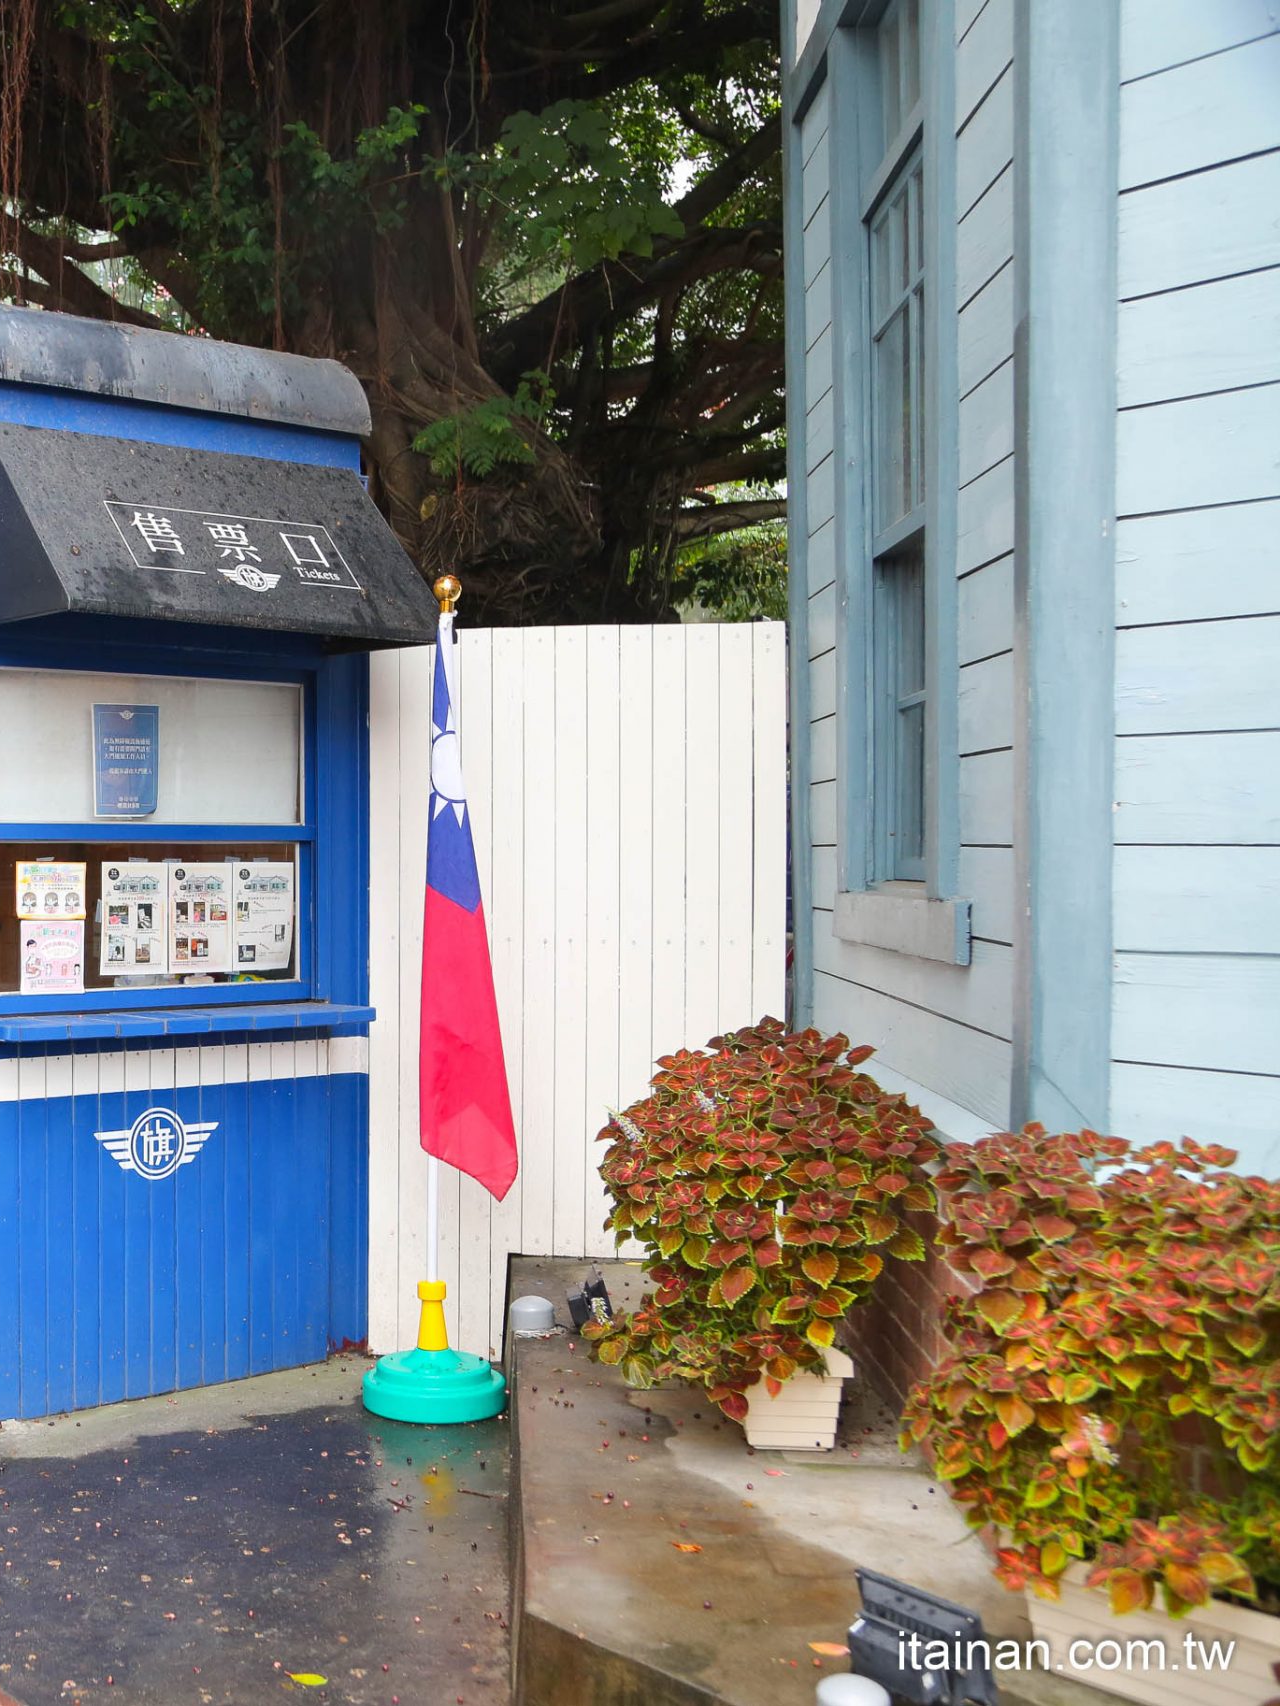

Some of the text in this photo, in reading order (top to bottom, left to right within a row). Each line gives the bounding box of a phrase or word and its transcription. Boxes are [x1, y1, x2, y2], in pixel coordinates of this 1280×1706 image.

[131, 511, 331, 569] 售票口
[293, 566, 341, 582] Tickets
[139, 1119, 176, 1166] 旗
